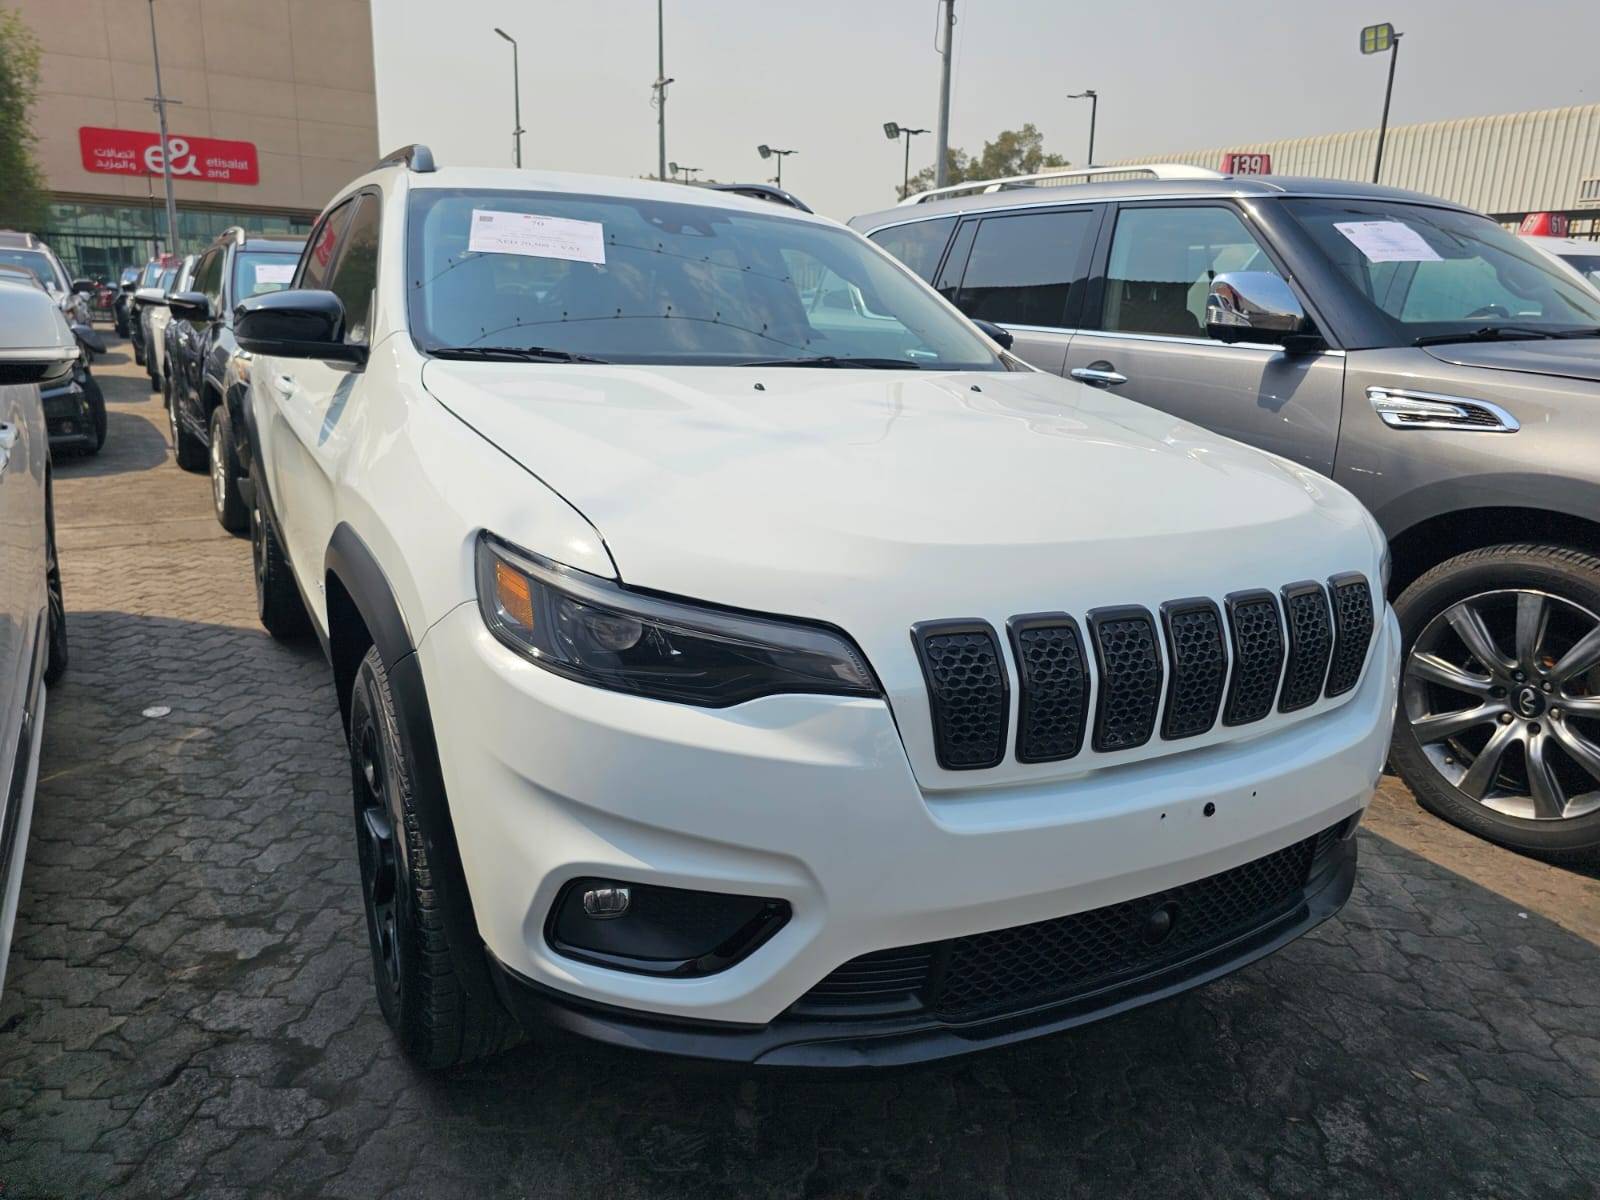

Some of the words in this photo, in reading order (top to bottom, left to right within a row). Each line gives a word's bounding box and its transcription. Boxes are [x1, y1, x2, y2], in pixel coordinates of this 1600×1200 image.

[93, 147, 136, 159] اتصالات
[206, 158, 248, 171] etisalat
[1232, 156, 1262, 176] 139
[207, 169, 231, 179] and
[1551, 215, 1562, 233] 61
